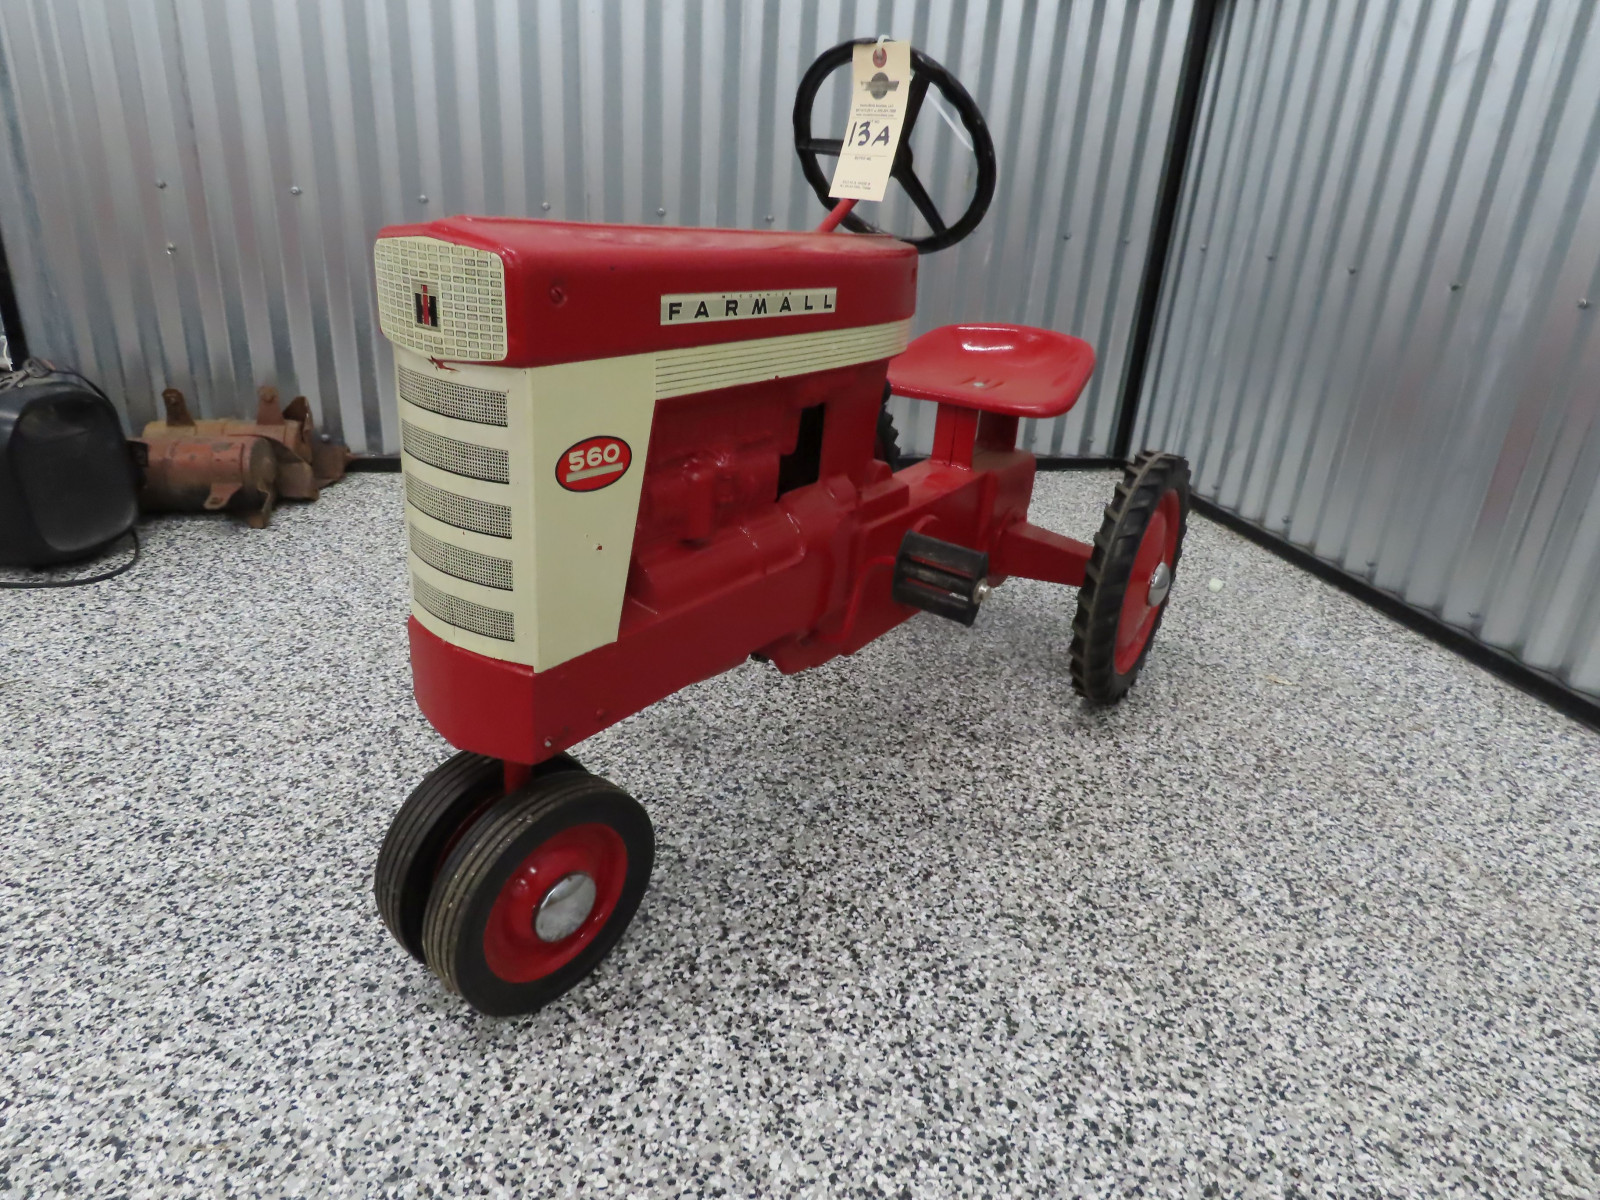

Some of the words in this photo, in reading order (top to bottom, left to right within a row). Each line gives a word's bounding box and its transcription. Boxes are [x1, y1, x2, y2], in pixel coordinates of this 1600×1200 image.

[848, 120, 890, 148] 13A
[668, 294, 833, 321] FARMALL
[568, 443, 621, 472] 560
